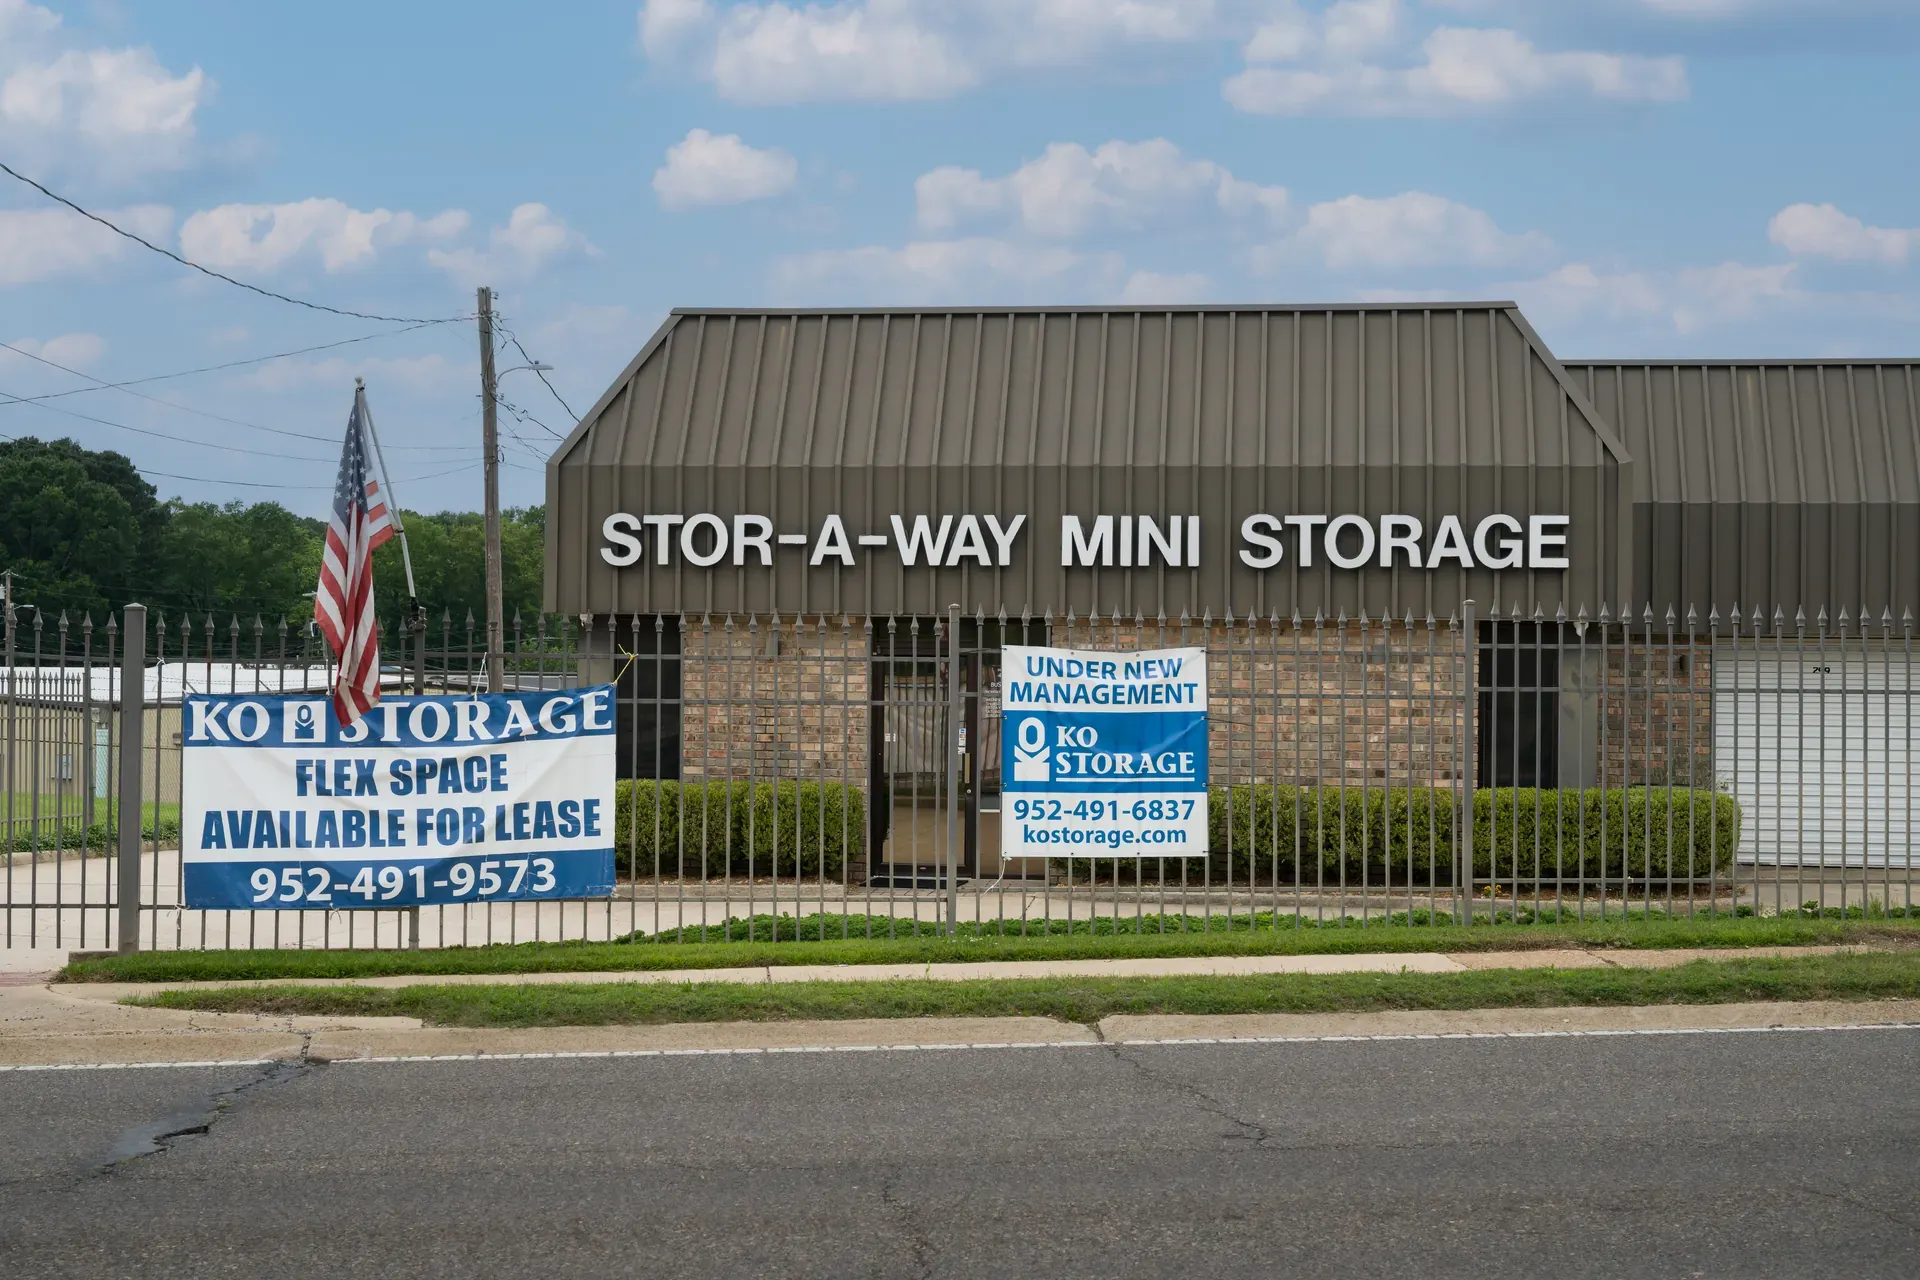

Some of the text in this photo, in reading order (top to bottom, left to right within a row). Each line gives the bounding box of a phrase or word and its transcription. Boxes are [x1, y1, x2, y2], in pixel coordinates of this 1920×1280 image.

[599, 512, 1571, 570] STOR-A-WAY MINI STORAGE
[1026, 656, 1117, 680] UNDER
[1125, 657, 1183, 680] NEW
[1009, 681, 1199, 705] MANAGEMENT
[188, 700, 271, 742] KO
[1055, 725, 1099, 748] KO
[295, 753, 509, 798] FLEX SPACE
[1055, 752, 1195, 775] STORAGE
[1013, 799, 1196, 821] 952-491-6837
[200, 798, 601, 851] AVAILABLE FOR LEASE
[1022, 824, 1187, 849] kostorage.com
[250, 857, 557, 903] 952-491-9573
